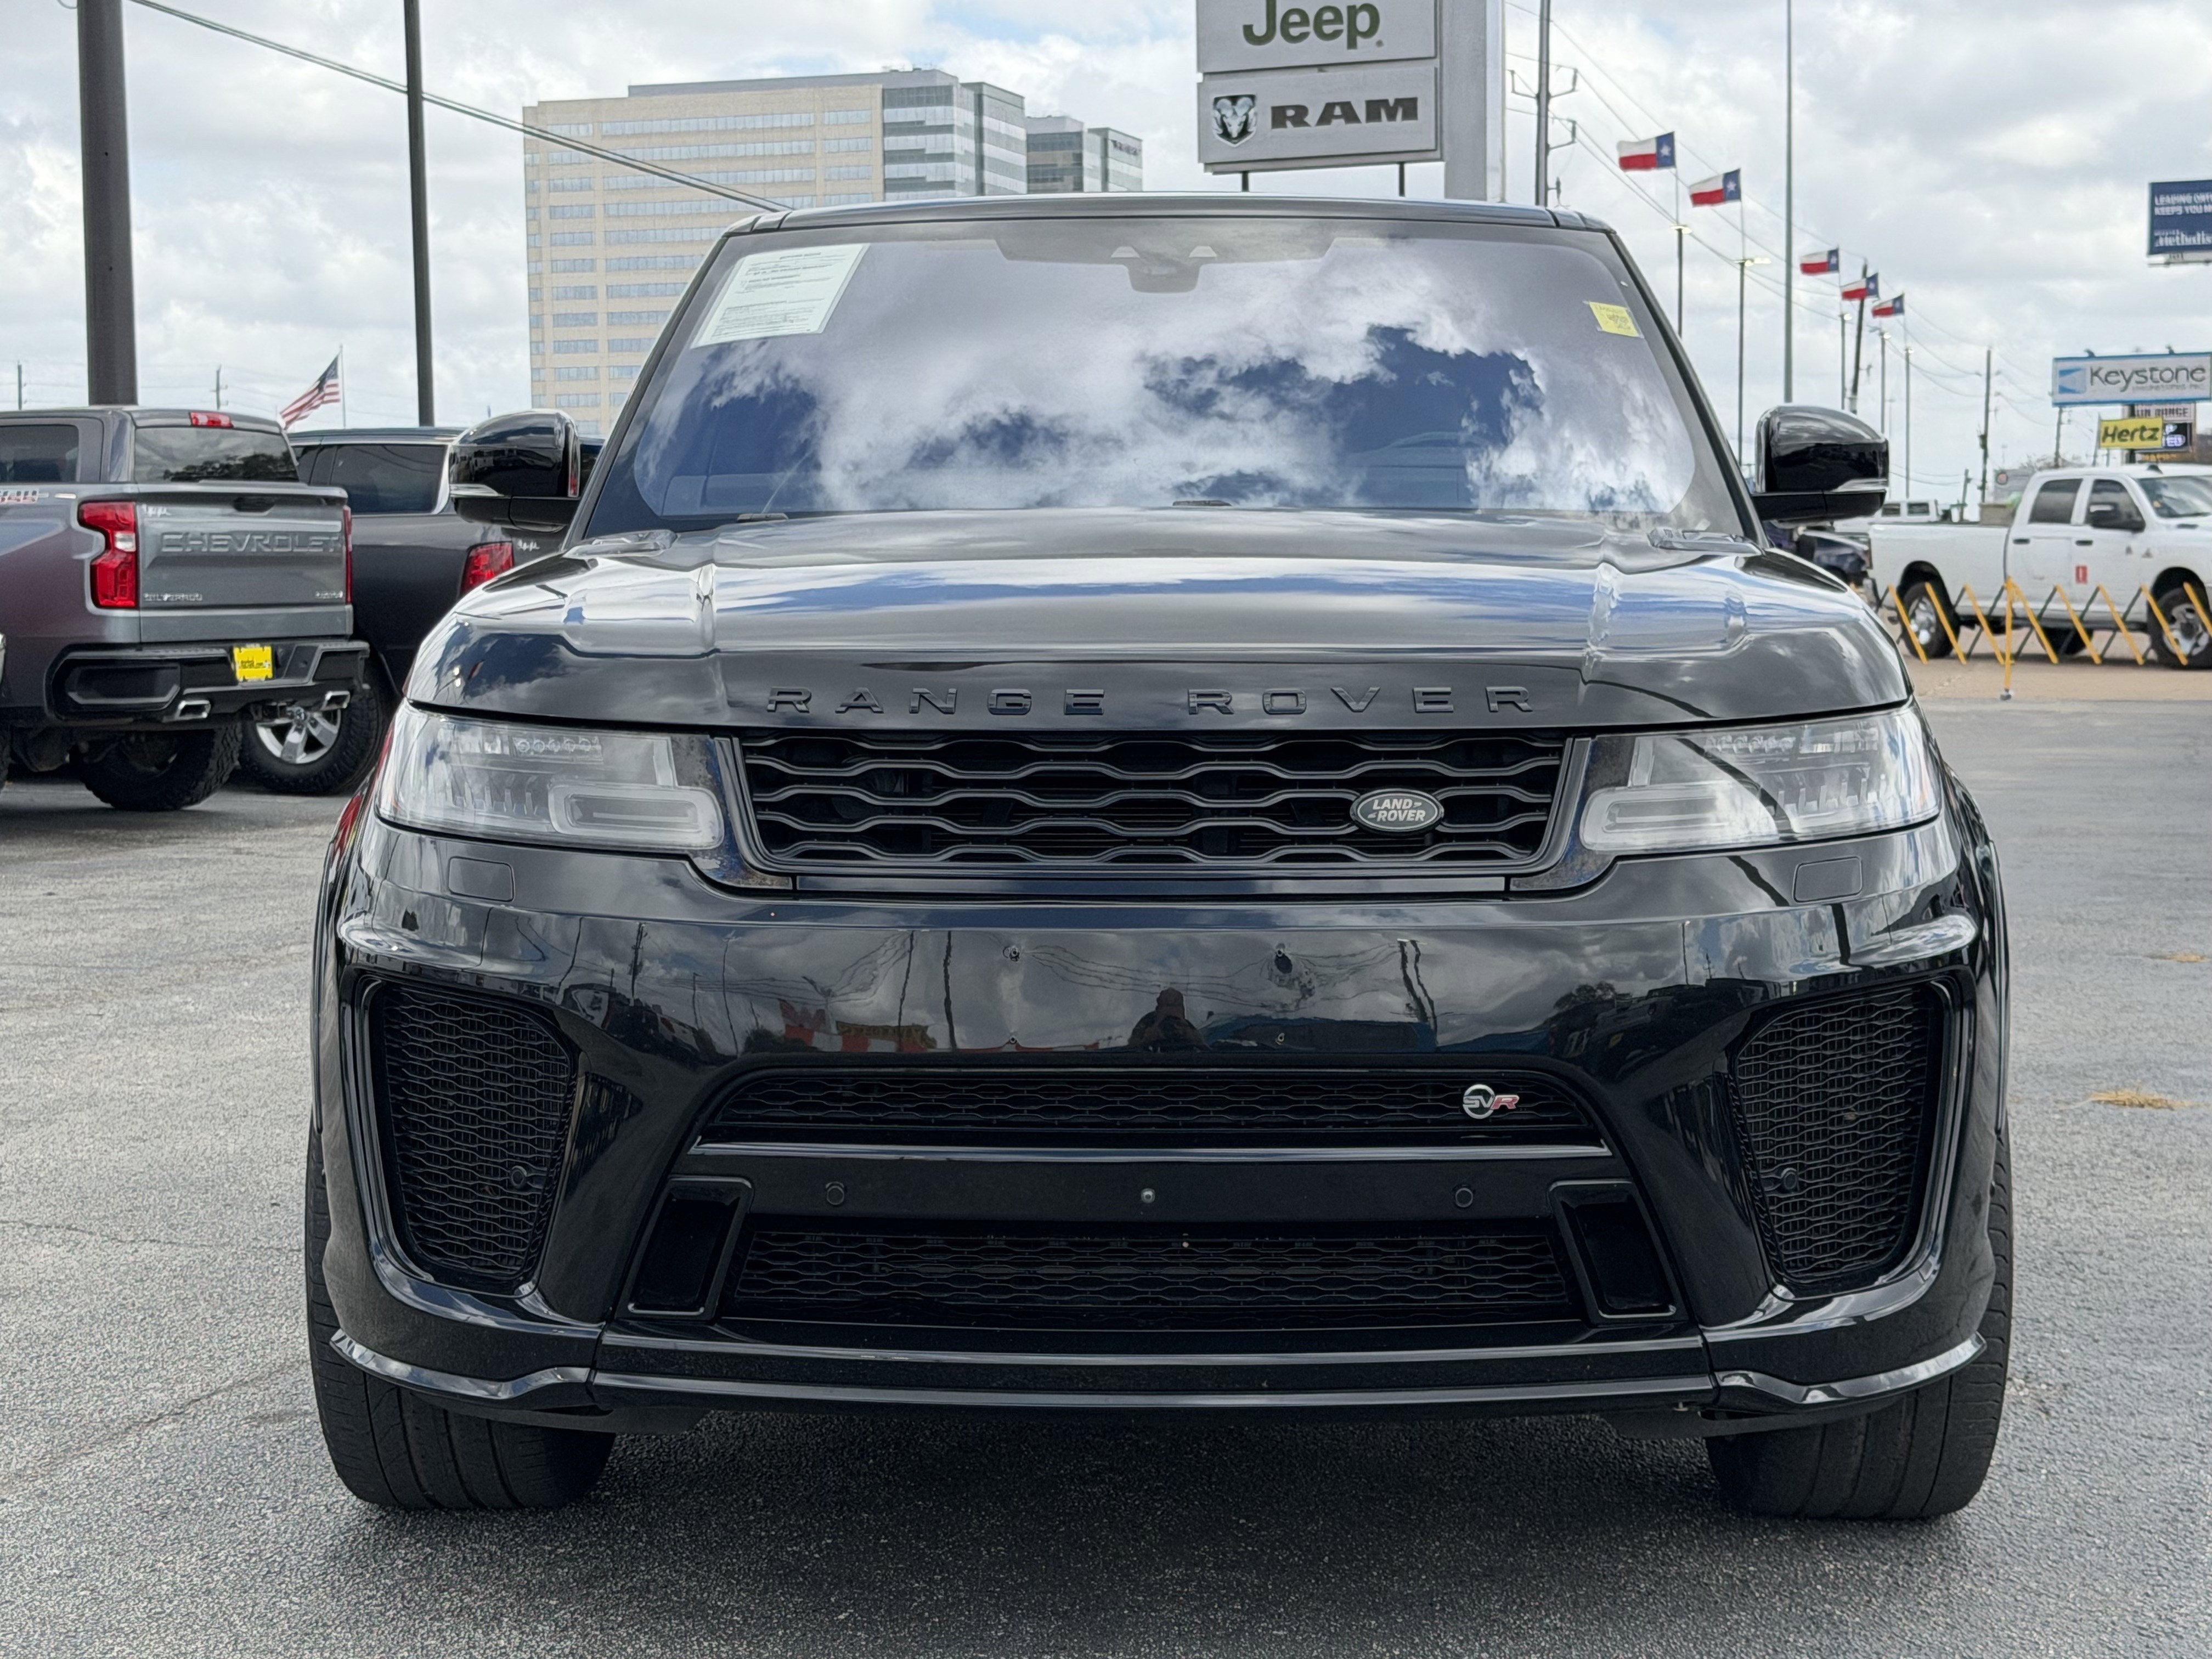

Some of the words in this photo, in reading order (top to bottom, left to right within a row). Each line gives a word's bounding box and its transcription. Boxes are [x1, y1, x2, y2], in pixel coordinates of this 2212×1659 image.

[1242, 0, 1381, 50] Jeep
[1270, 97, 1419, 130] RAM
[2089, 365, 2207, 392] Keystone
[2101, 424, 2161, 443] Hertz
[161, 532, 341, 552] CHEVROLET
[766, 685, 1105, 715] RANGE
[1187, 685, 1534, 715] ROVER
